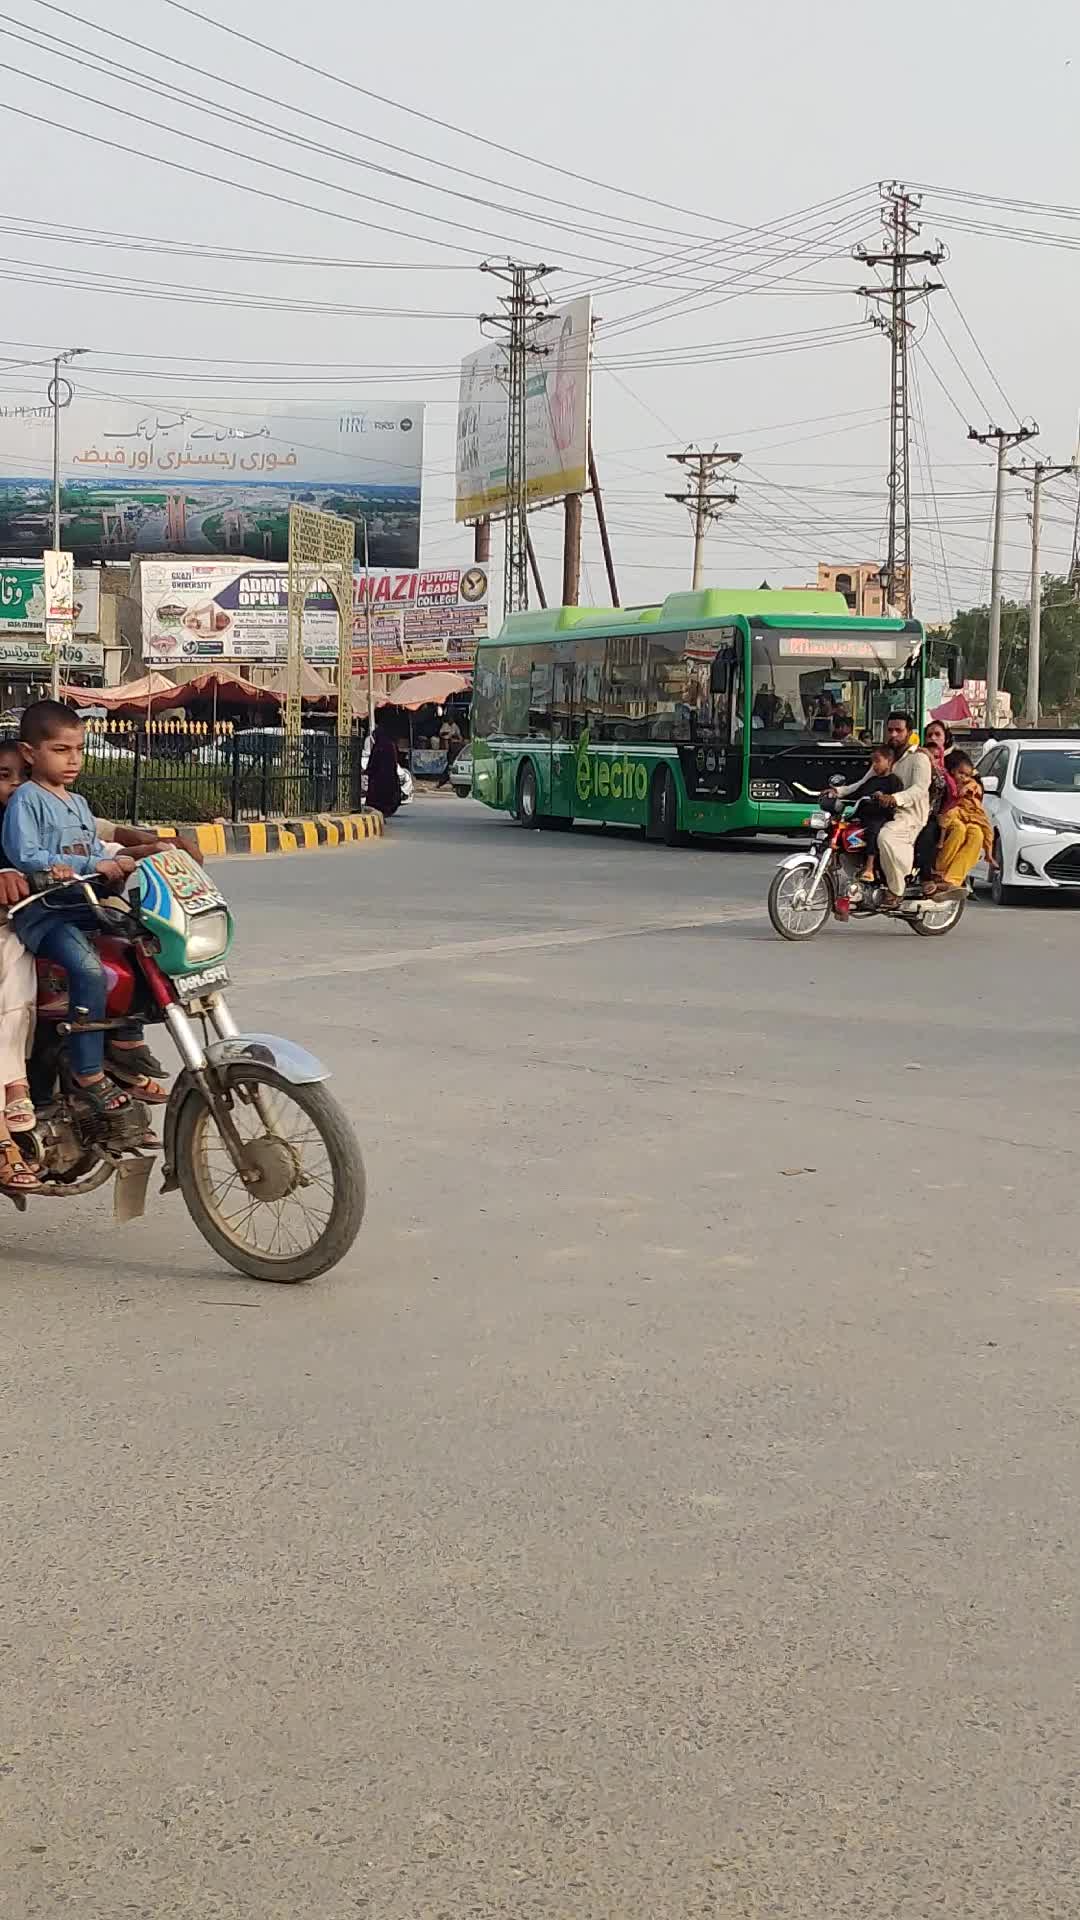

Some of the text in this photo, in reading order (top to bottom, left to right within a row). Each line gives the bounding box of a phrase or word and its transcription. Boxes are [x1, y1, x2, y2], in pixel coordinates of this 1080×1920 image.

[72, 443, 298, 471] فوری رجسٹری اور قبضہ
[420, 571, 459, 583] FUTURE
[171, 581, 212, 589] UNIVERSITY
[419, 582, 458, 595] LEADS
[238, 592, 279, 605] OPEN
[418, 594, 457, 607] COLLEGE
[577, 750, 648, 800] electro
